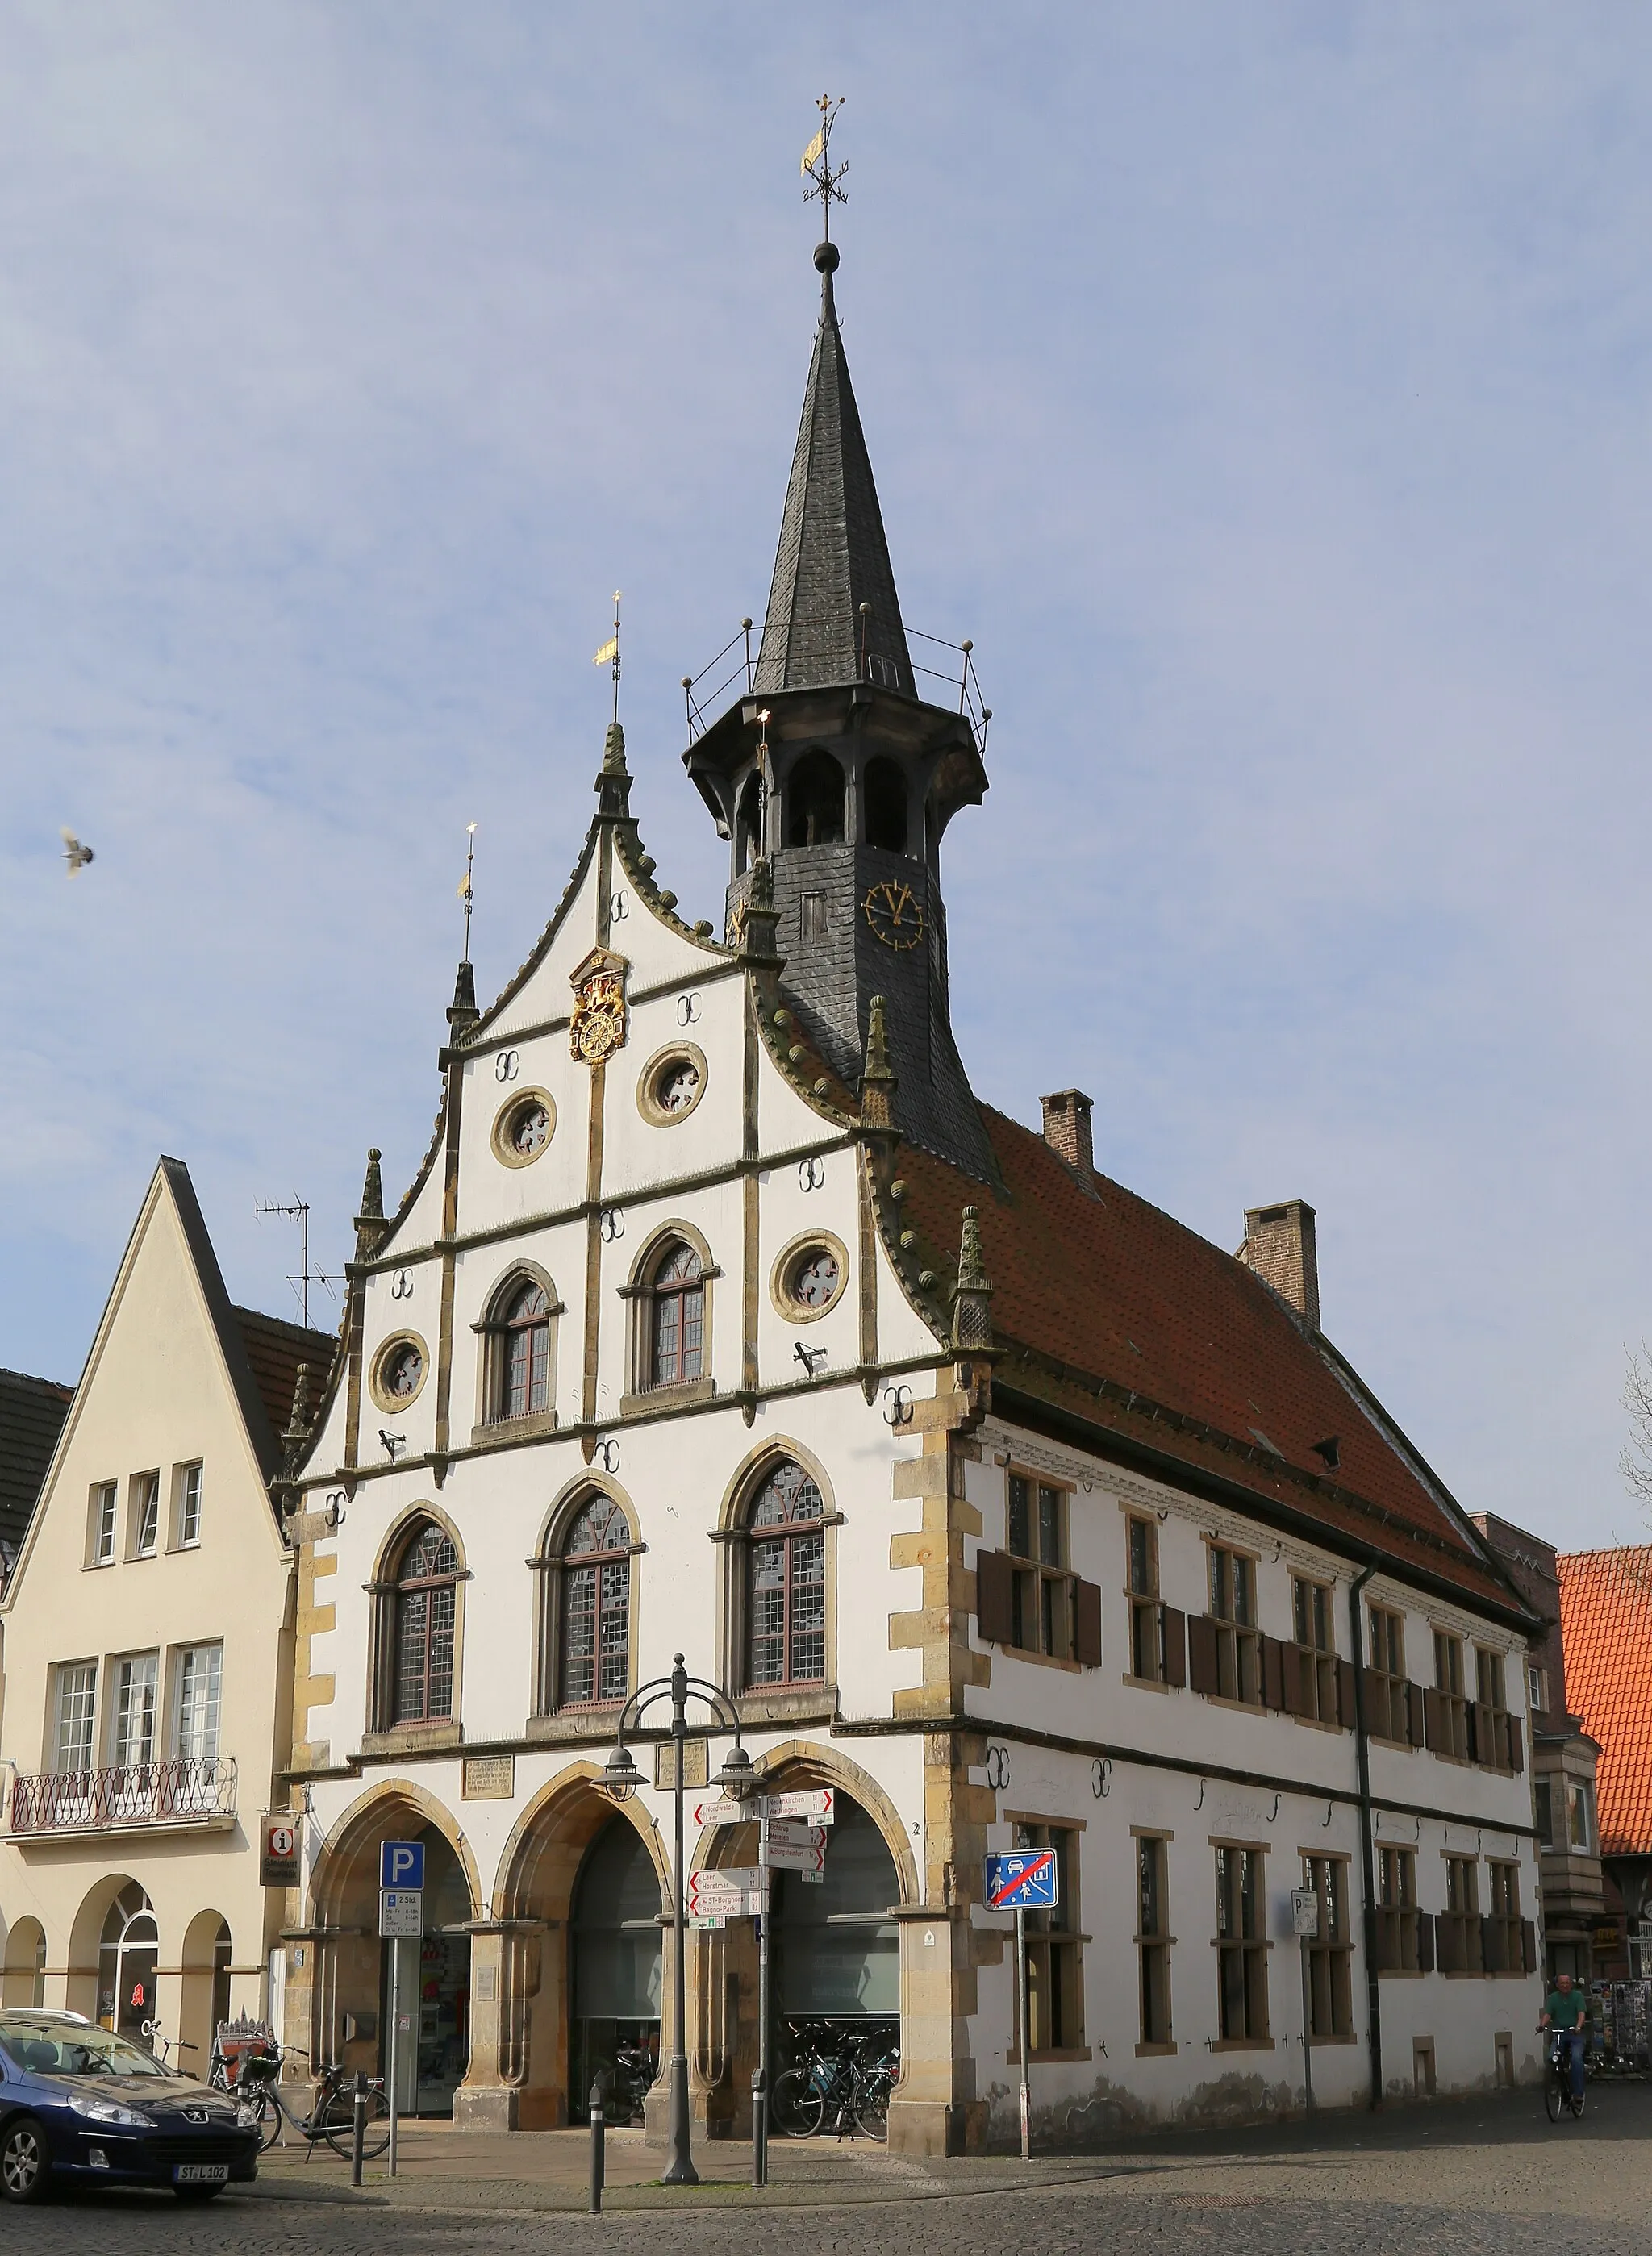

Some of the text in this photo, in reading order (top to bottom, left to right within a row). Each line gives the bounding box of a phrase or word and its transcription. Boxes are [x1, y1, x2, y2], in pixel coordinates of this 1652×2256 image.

[769, 1796, 805, 1806] Neuenkirchen
[705, 1803, 735, 1813] Nordwalde
[769, 1806, 798, 1816] Wettringen
[706, 1814, 718, 1822] Leer
[770, 1822, 789, 1833] Ochtrup
[912, 1821, 920, 1835] 2
[774, 1847, 804, 1858] Burgsteinfurt
[265, 1858, 298, 1868] Steinfurt
[392, 1848, 415, 1883] P
[702, 1882, 729, 1890] Horstmar
[708, 1895, 746, 1904] ST-Borghorst
[702, 1904, 736, 1915] Bagno-Park
[1295, 1898, 1302, 1915] P
[181, 2166, 225, 2178] ST L 102
